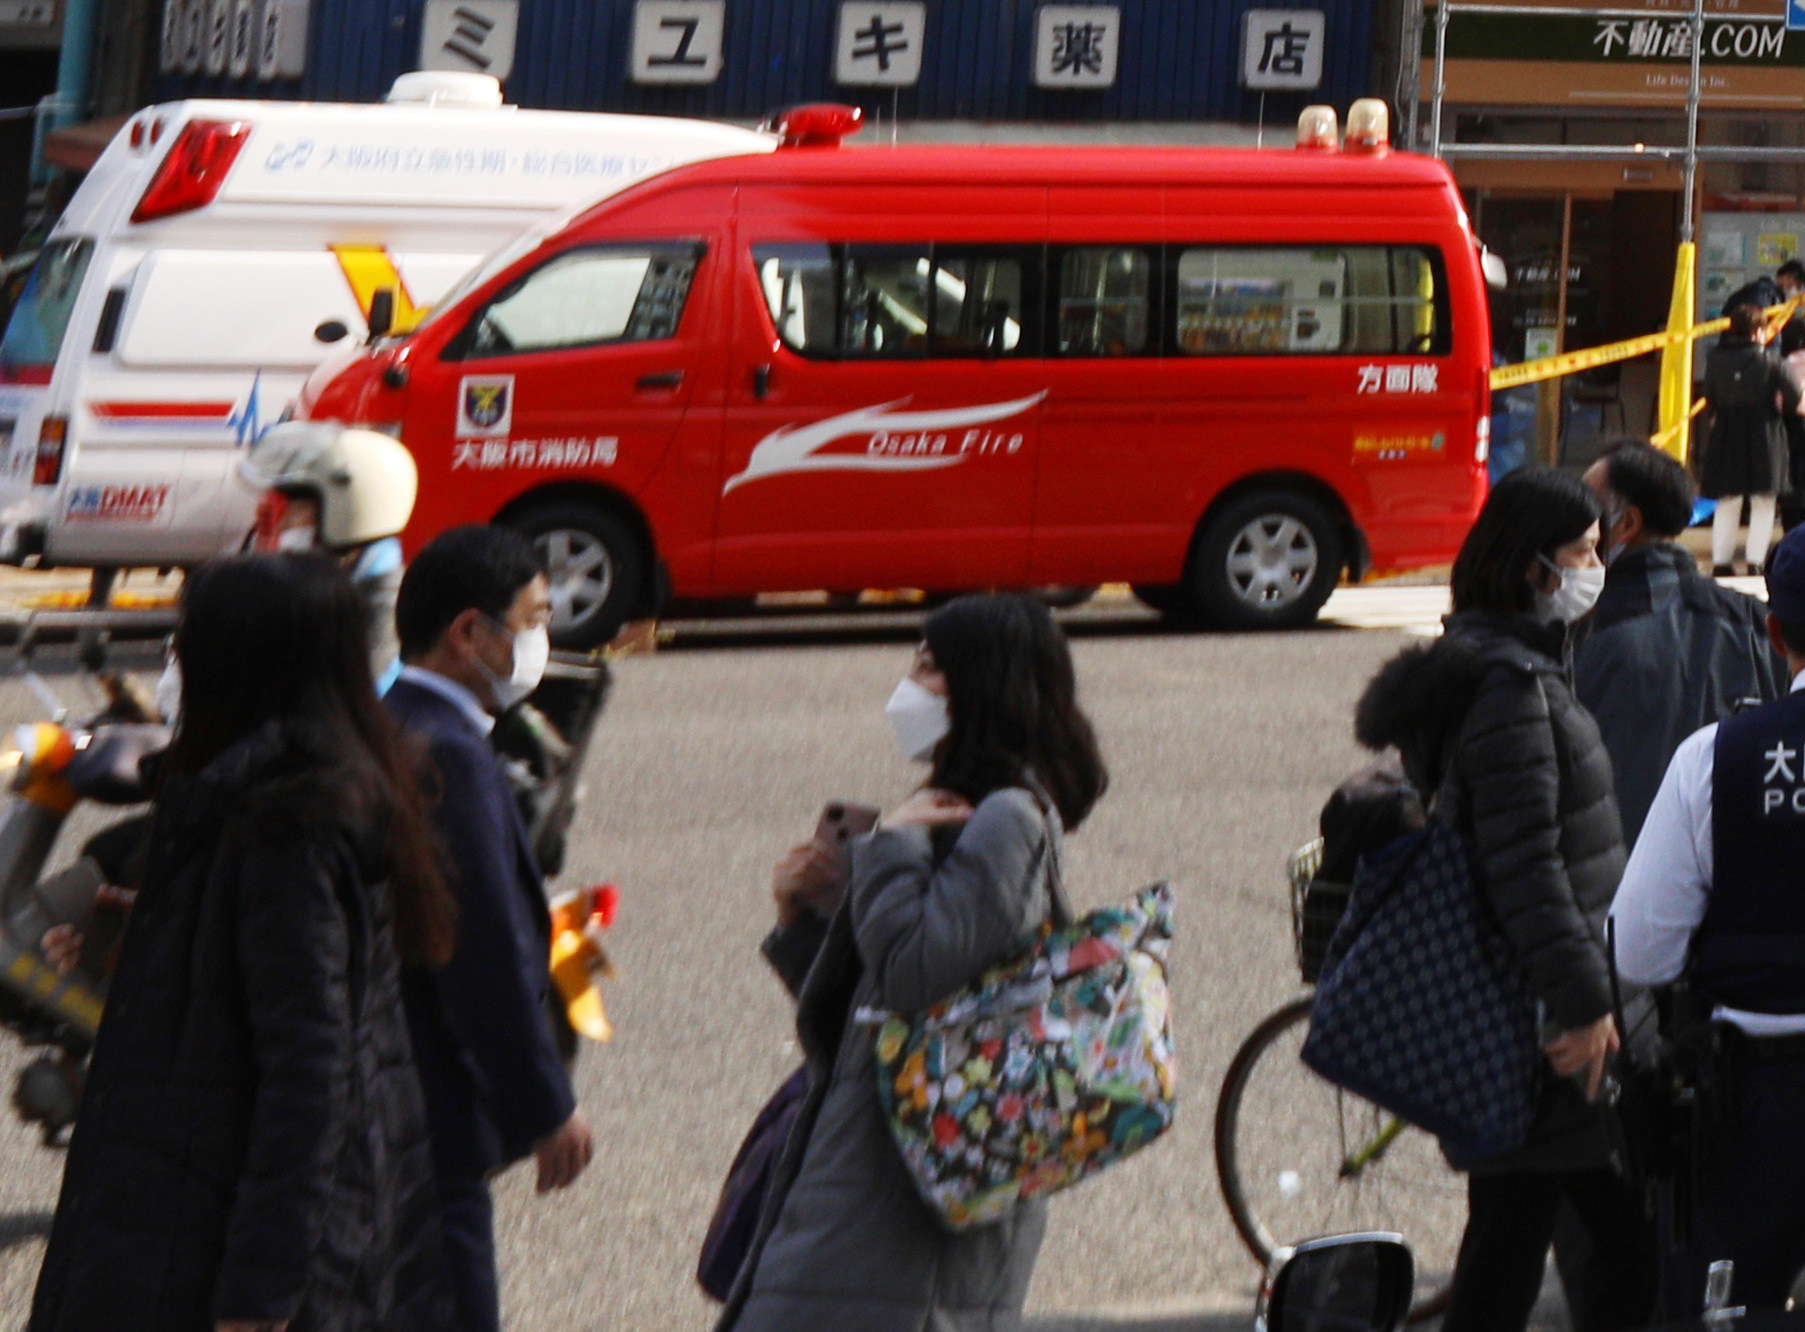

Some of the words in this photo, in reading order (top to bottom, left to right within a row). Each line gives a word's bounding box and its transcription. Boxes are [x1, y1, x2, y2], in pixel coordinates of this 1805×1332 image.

[1593, 19, 1786, 59] 不動産.COM
[1356, 363, 1439, 395] 方面隊
[450, 436, 619, 472] 大阪市消防局
[865, 429, 947, 457] Osaka
[959, 429, 1024, 456] Fire
